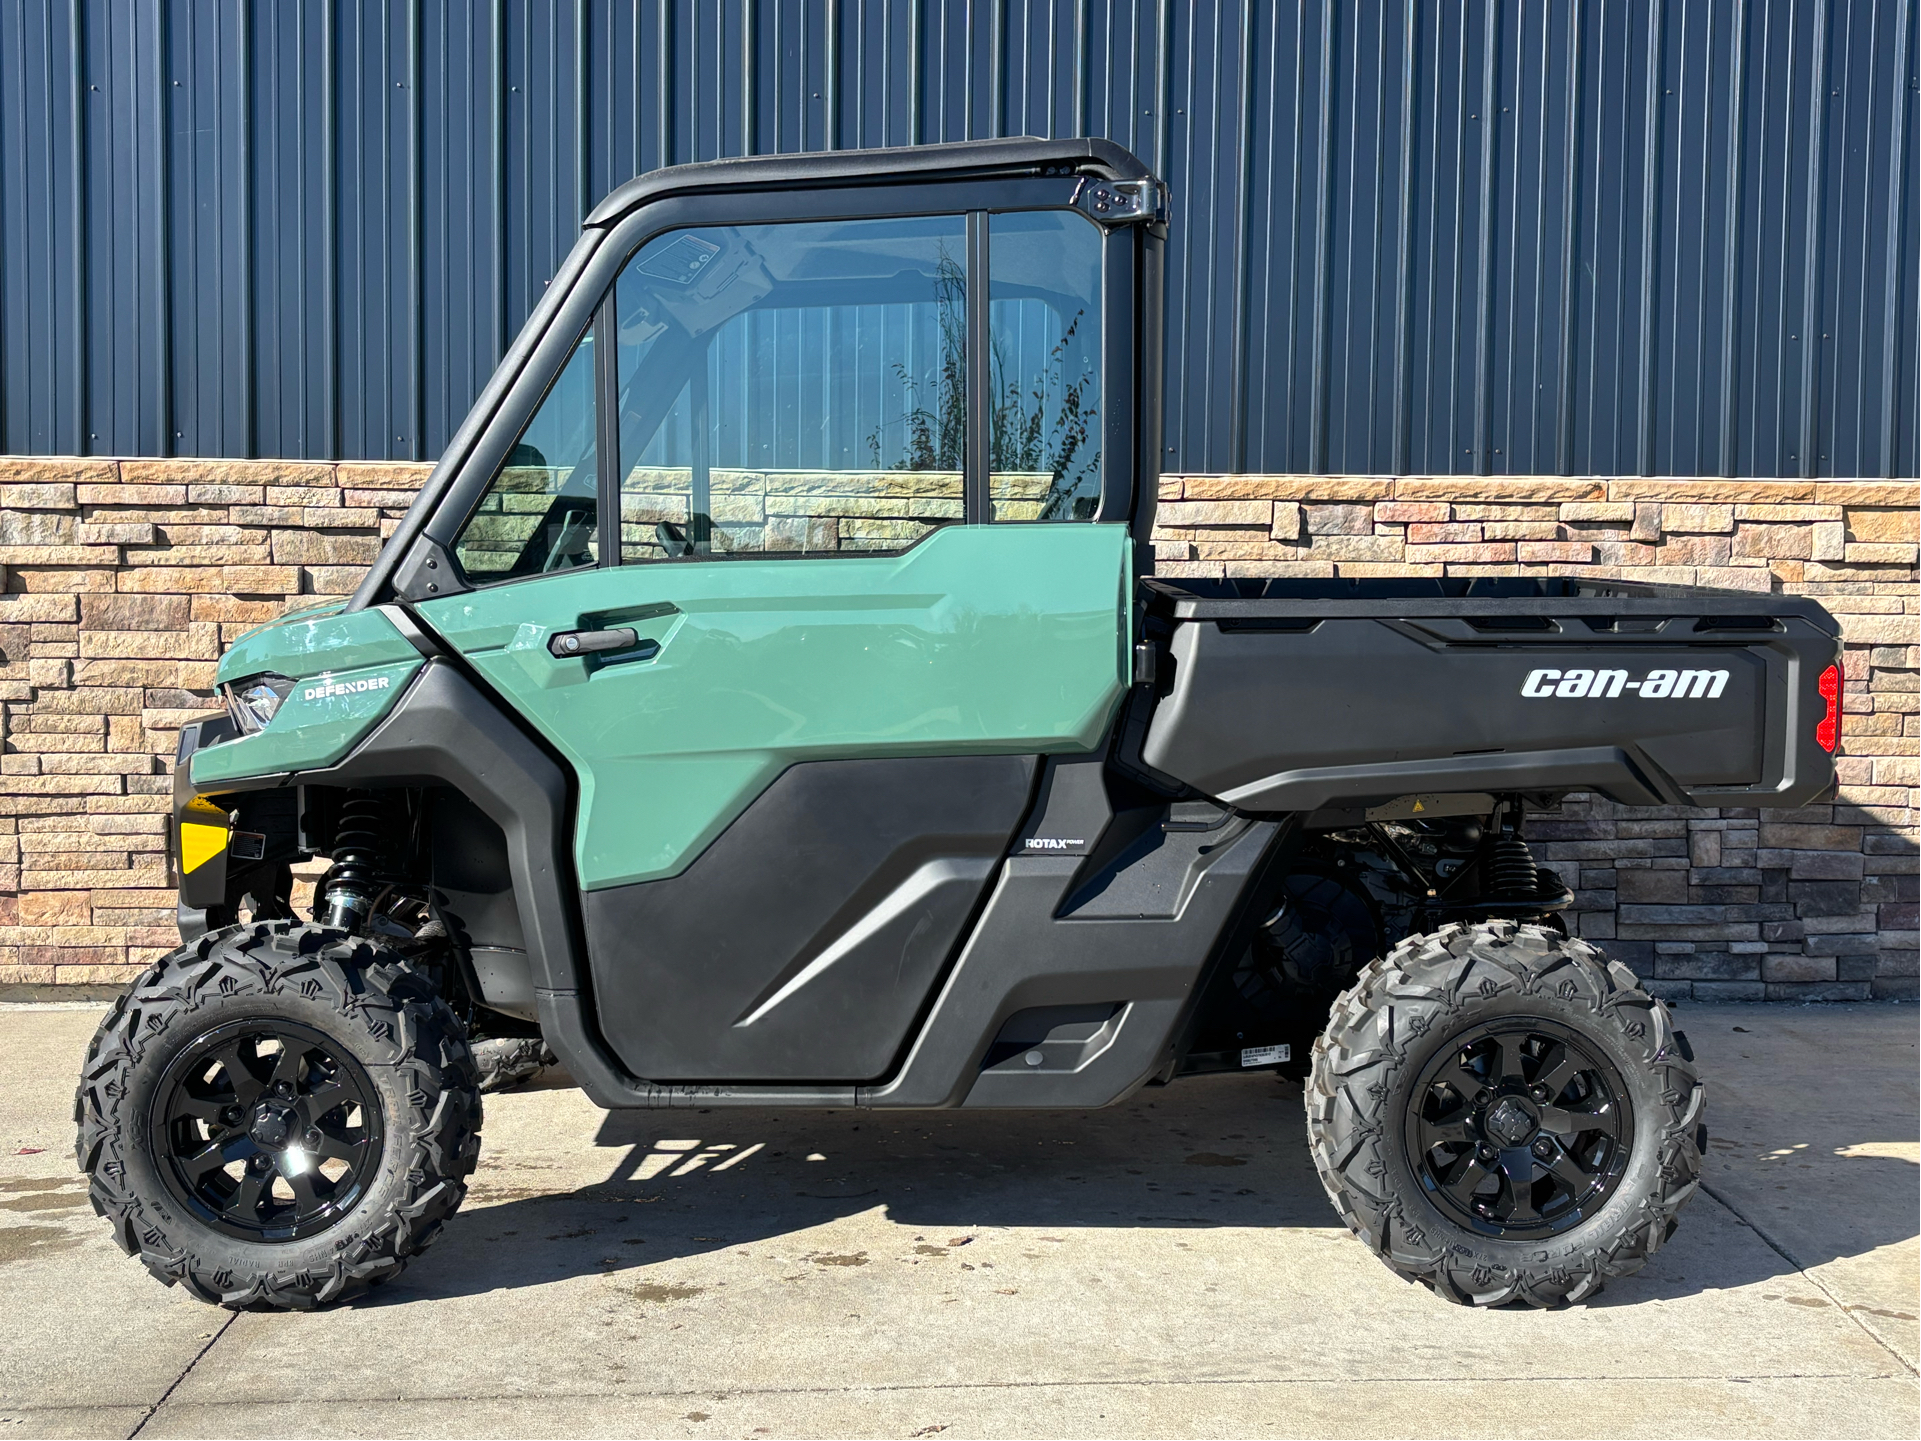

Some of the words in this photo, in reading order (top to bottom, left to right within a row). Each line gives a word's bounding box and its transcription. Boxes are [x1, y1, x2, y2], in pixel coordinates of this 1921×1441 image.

[304, 677, 389, 700] DEFENDER
[1520, 669, 1730, 698] can-am
[1025, 838, 1067, 849] ROTAX
